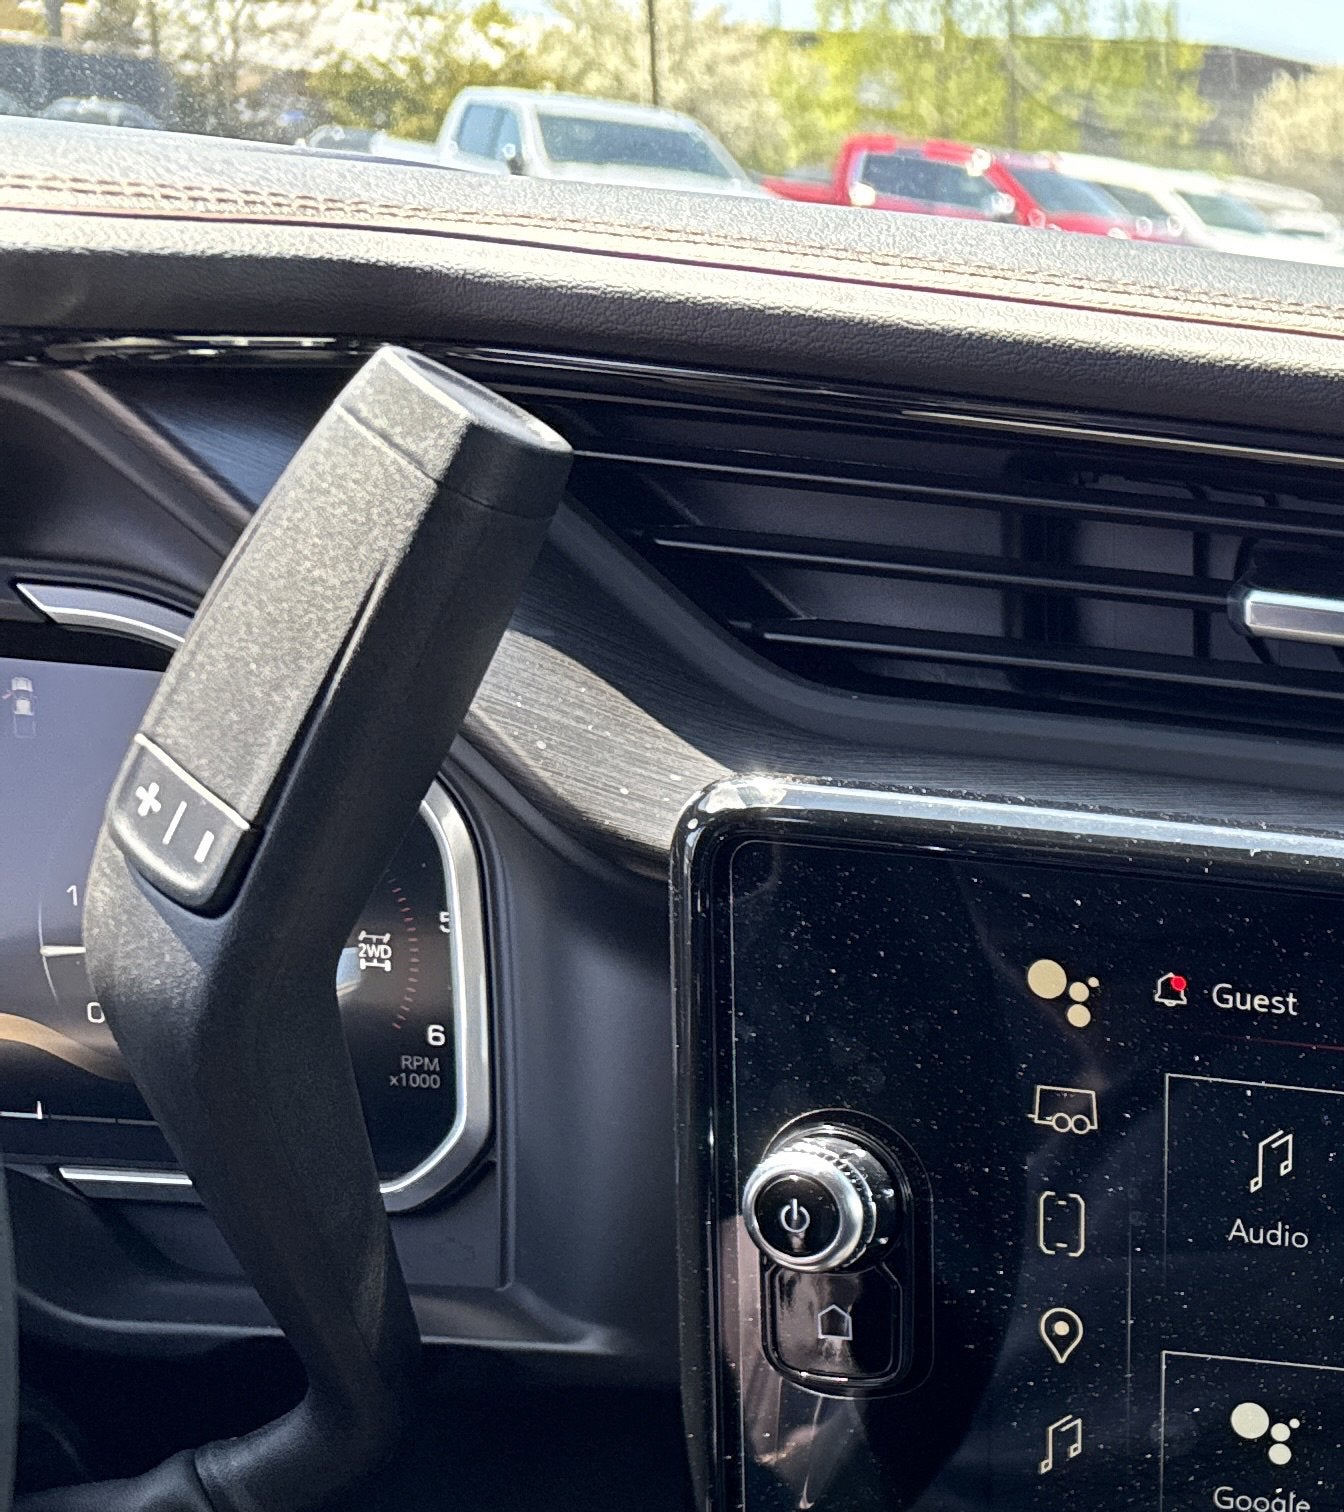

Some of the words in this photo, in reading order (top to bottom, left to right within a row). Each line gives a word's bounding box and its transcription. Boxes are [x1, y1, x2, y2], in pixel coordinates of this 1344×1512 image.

[66, 885, 78, 906] 1
[358, 943, 392, 959] 2WD
[1212, 983, 1298, 1016] Guest
[87, 1002, 106, 1024] 0
[426, 1024, 446, 1047] 6
[401, 1055, 440, 1072] RPM
[389, 1072, 441, 1089] x1000
[1228, 1218, 1309, 1250] Audio
